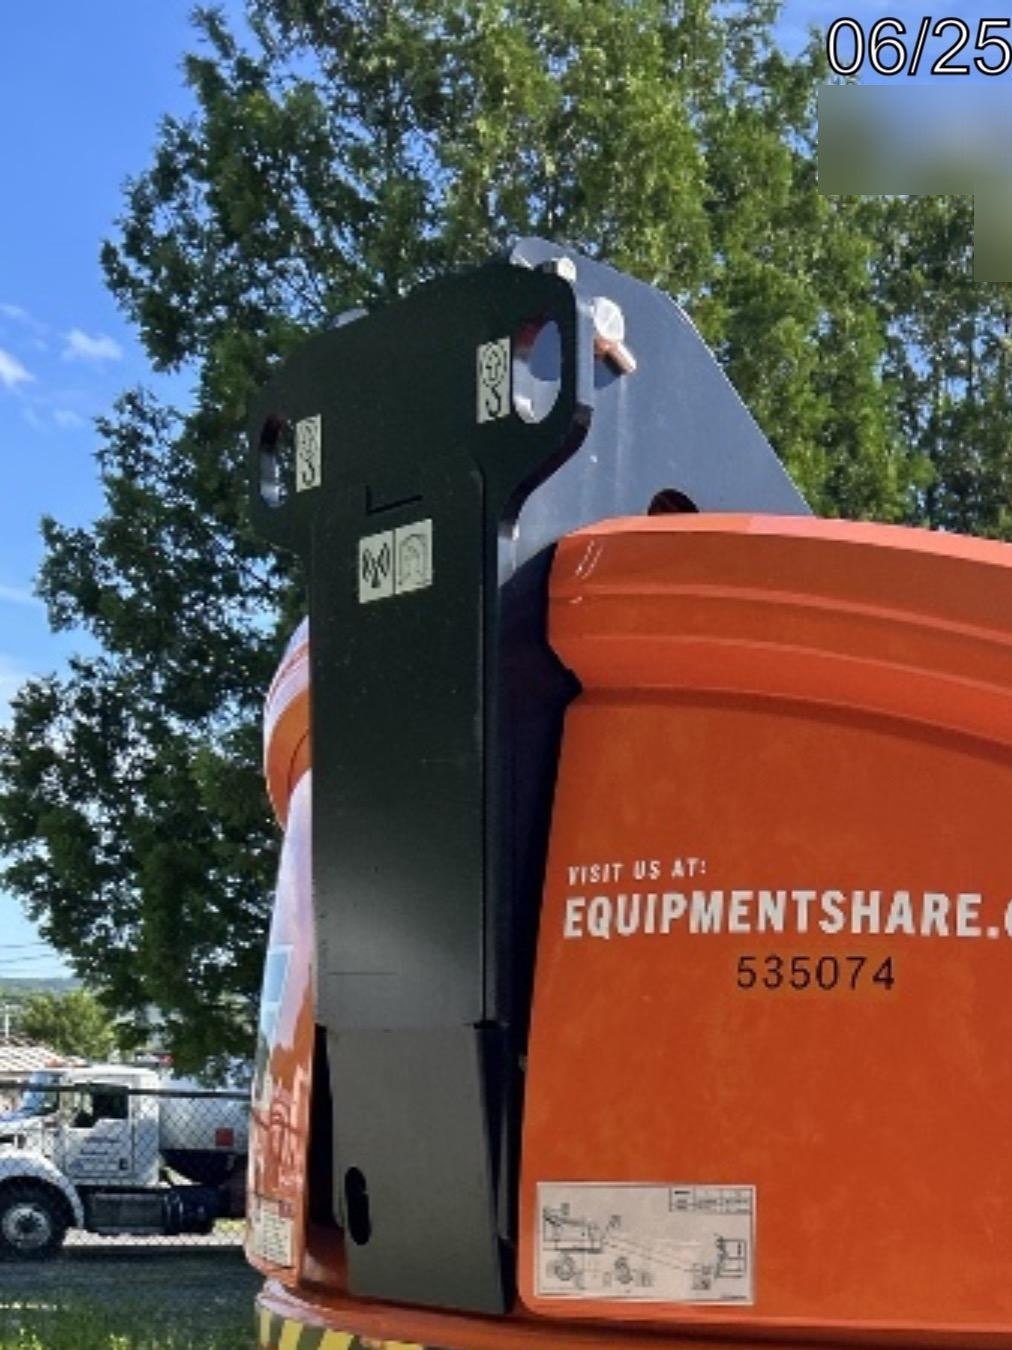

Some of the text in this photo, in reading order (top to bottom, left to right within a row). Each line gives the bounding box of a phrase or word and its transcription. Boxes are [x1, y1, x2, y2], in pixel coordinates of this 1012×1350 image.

[568, 857, 706, 885] VISIT US AT:
[736, 955, 895, 991] 535074
